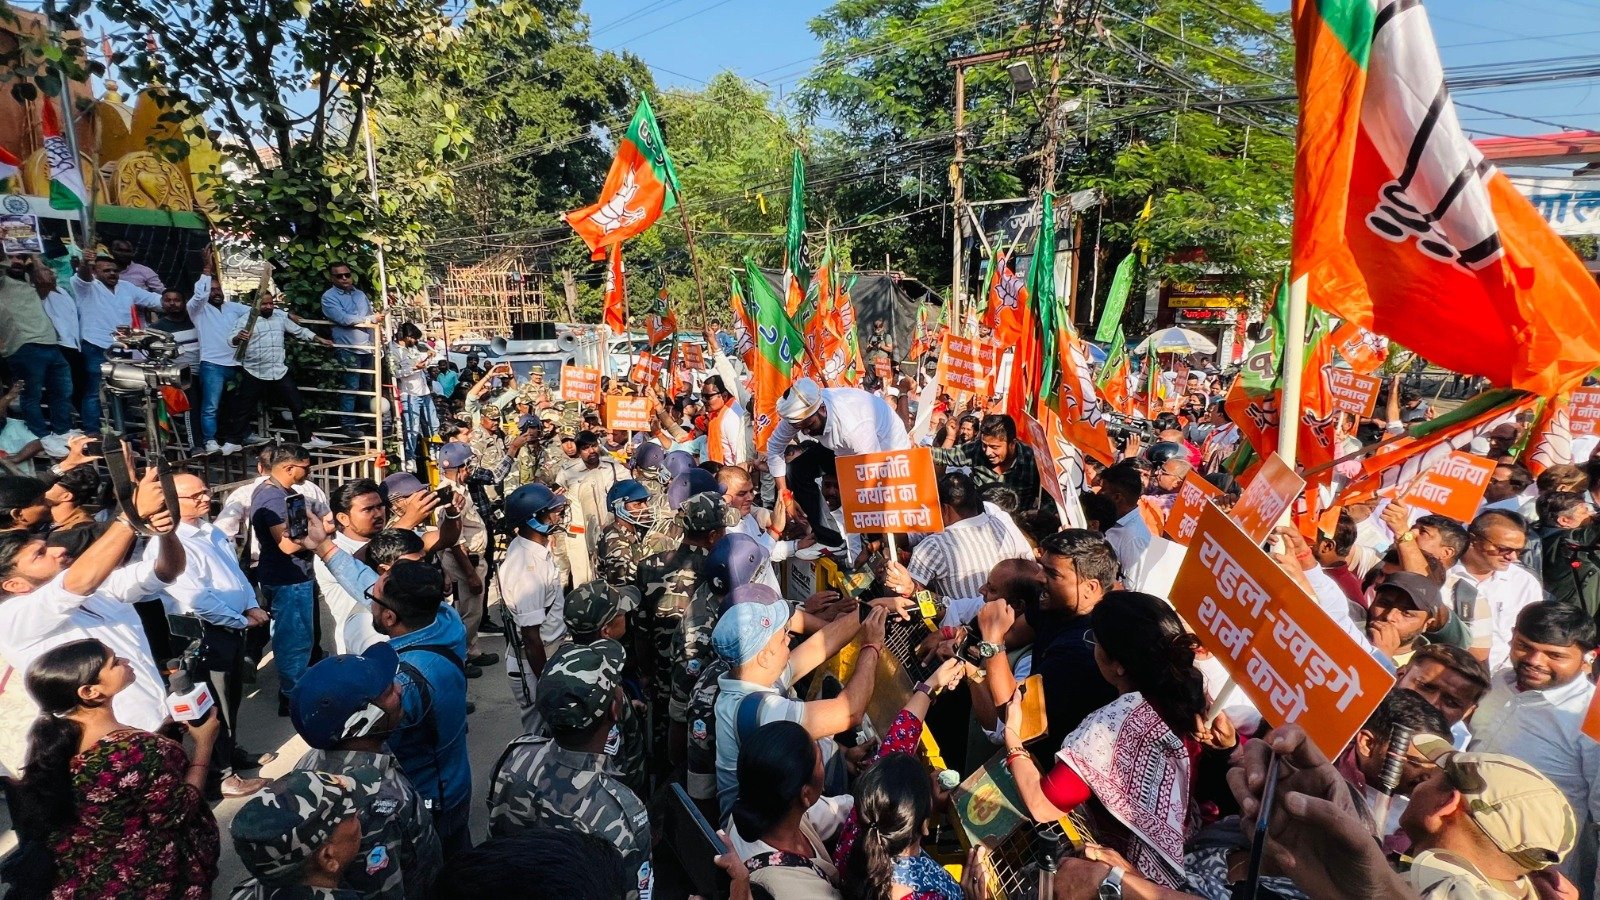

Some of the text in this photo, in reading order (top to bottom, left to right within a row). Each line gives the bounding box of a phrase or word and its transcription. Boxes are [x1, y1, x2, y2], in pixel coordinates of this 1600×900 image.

[1331, 385, 1371, 402] पमान
[1355, 378, 1375, 391] का
[1339, 398, 1367, 414] करो
[1571, 419, 1596, 433] करो
[854, 454, 911, 482] राजनीति
[855, 482, 917, 505] मर्यादा का
[851, 504, 931, 529] सम्मान करो
[1199, 531, 1364, 713] राहुल-खड़गे
[1197, 595, 1254, 661] शर्म
[1246, 647, 1309, 724] करो
